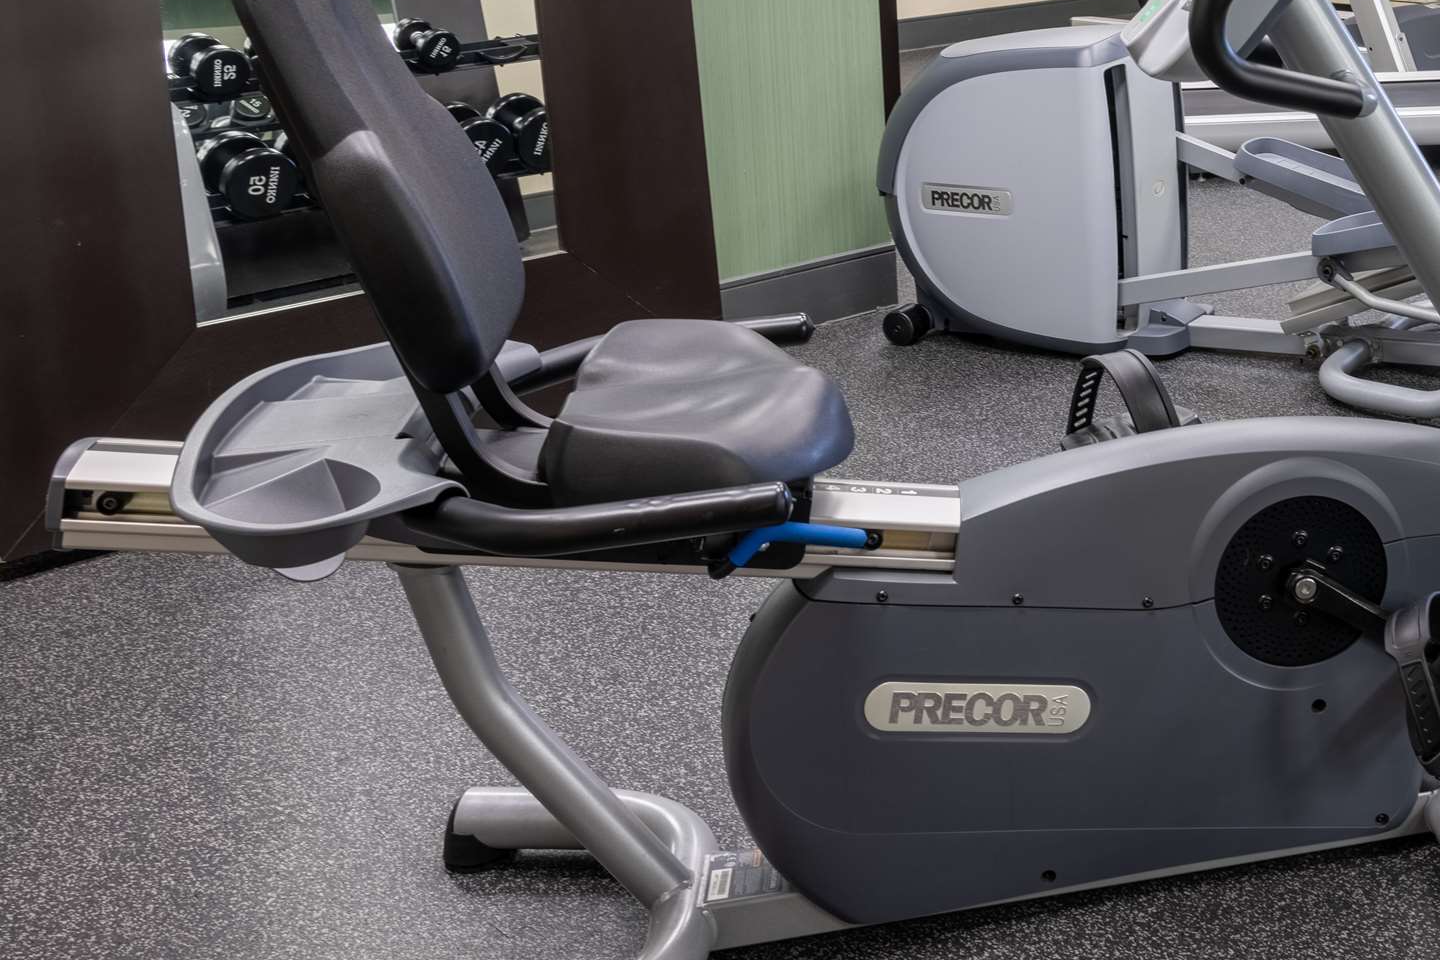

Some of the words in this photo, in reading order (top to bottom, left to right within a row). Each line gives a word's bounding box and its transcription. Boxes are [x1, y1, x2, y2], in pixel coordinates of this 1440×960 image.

[931, 190, 993, 211] PRECOR
[888, 692, 1049, 727] PRECOR
[1048, 693, 1070, 727] USA
